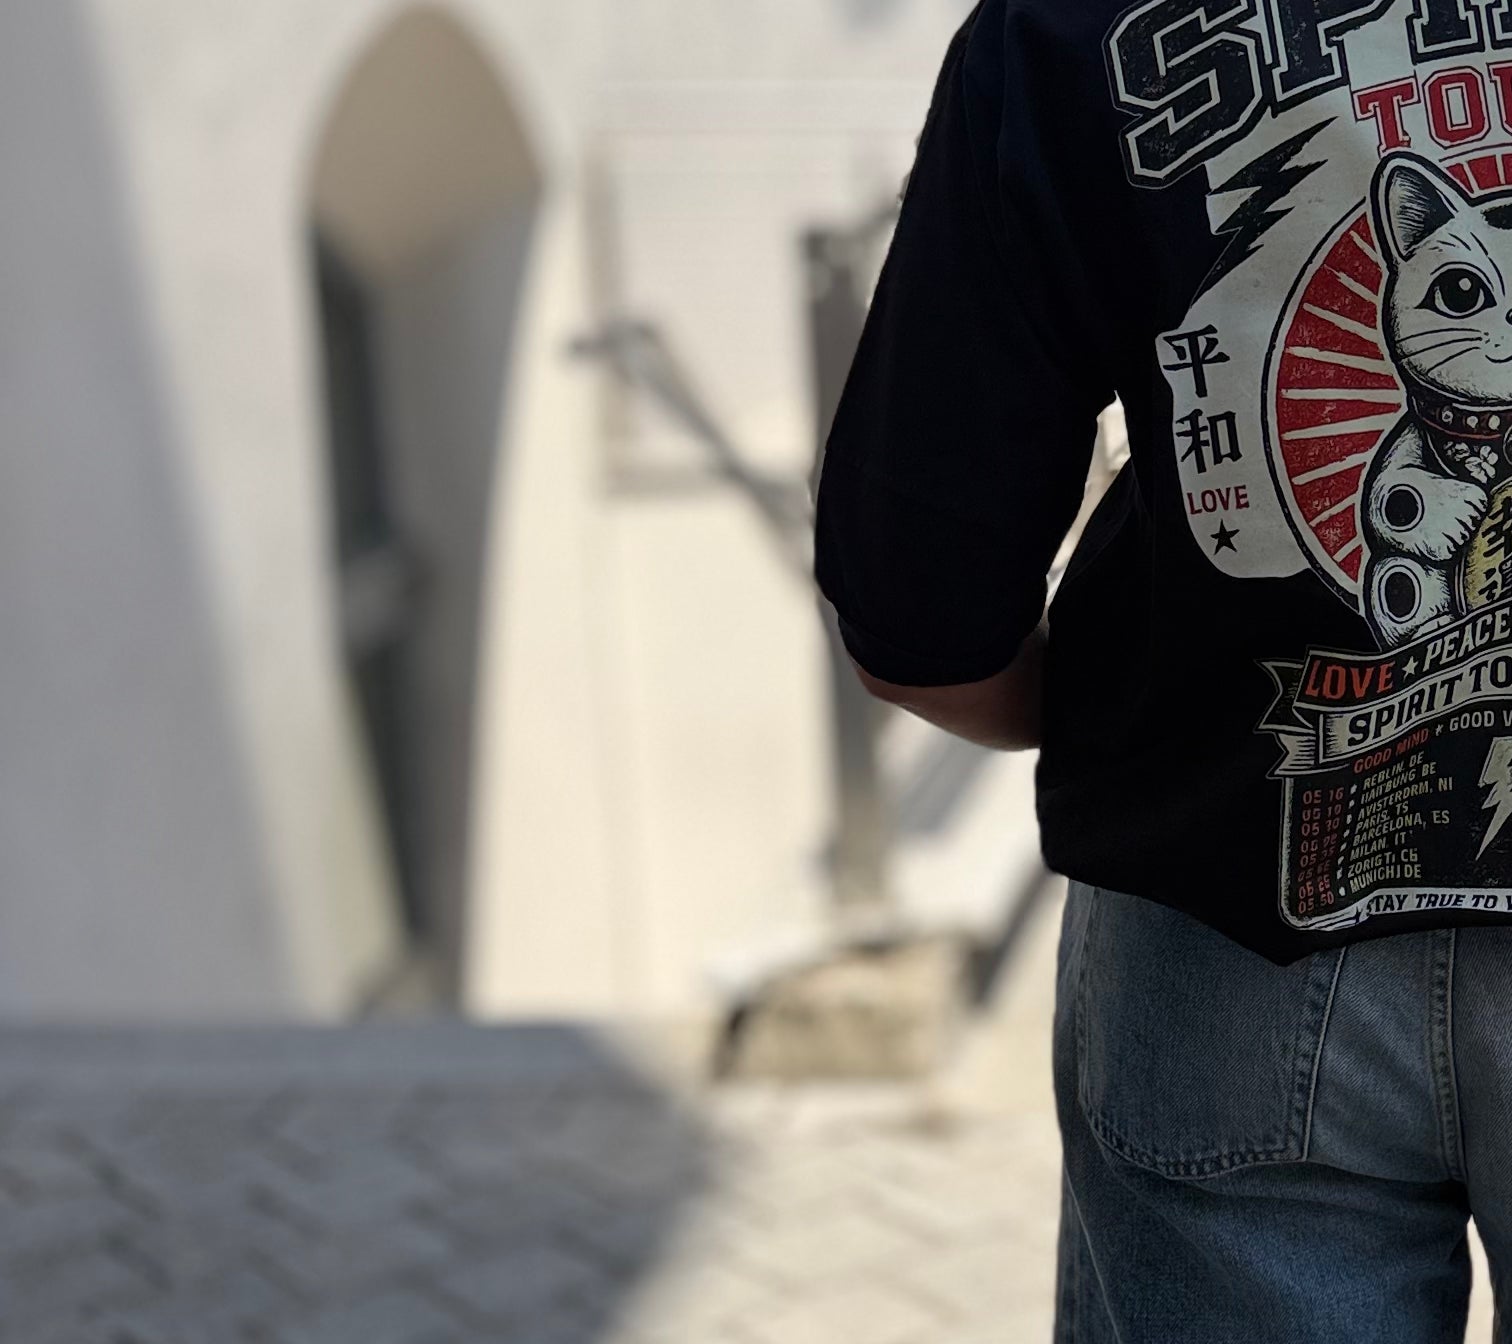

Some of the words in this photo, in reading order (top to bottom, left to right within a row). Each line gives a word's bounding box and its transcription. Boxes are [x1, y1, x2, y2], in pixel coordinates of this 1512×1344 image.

[1163, 324, 1243, 474] 平和
[1187, 485, 1250, 515] LOVE
[1305, 659, 1395, 699] LOVE
[1424, 607, 1511, 671] PEACE
[1348, 676, 1461, 746] SPIRIT
[1450, 711, 1495, 731] GOOD
[1415, 894, 1466, 908] TRUE
[1471, 895, 1498, 909] TO
